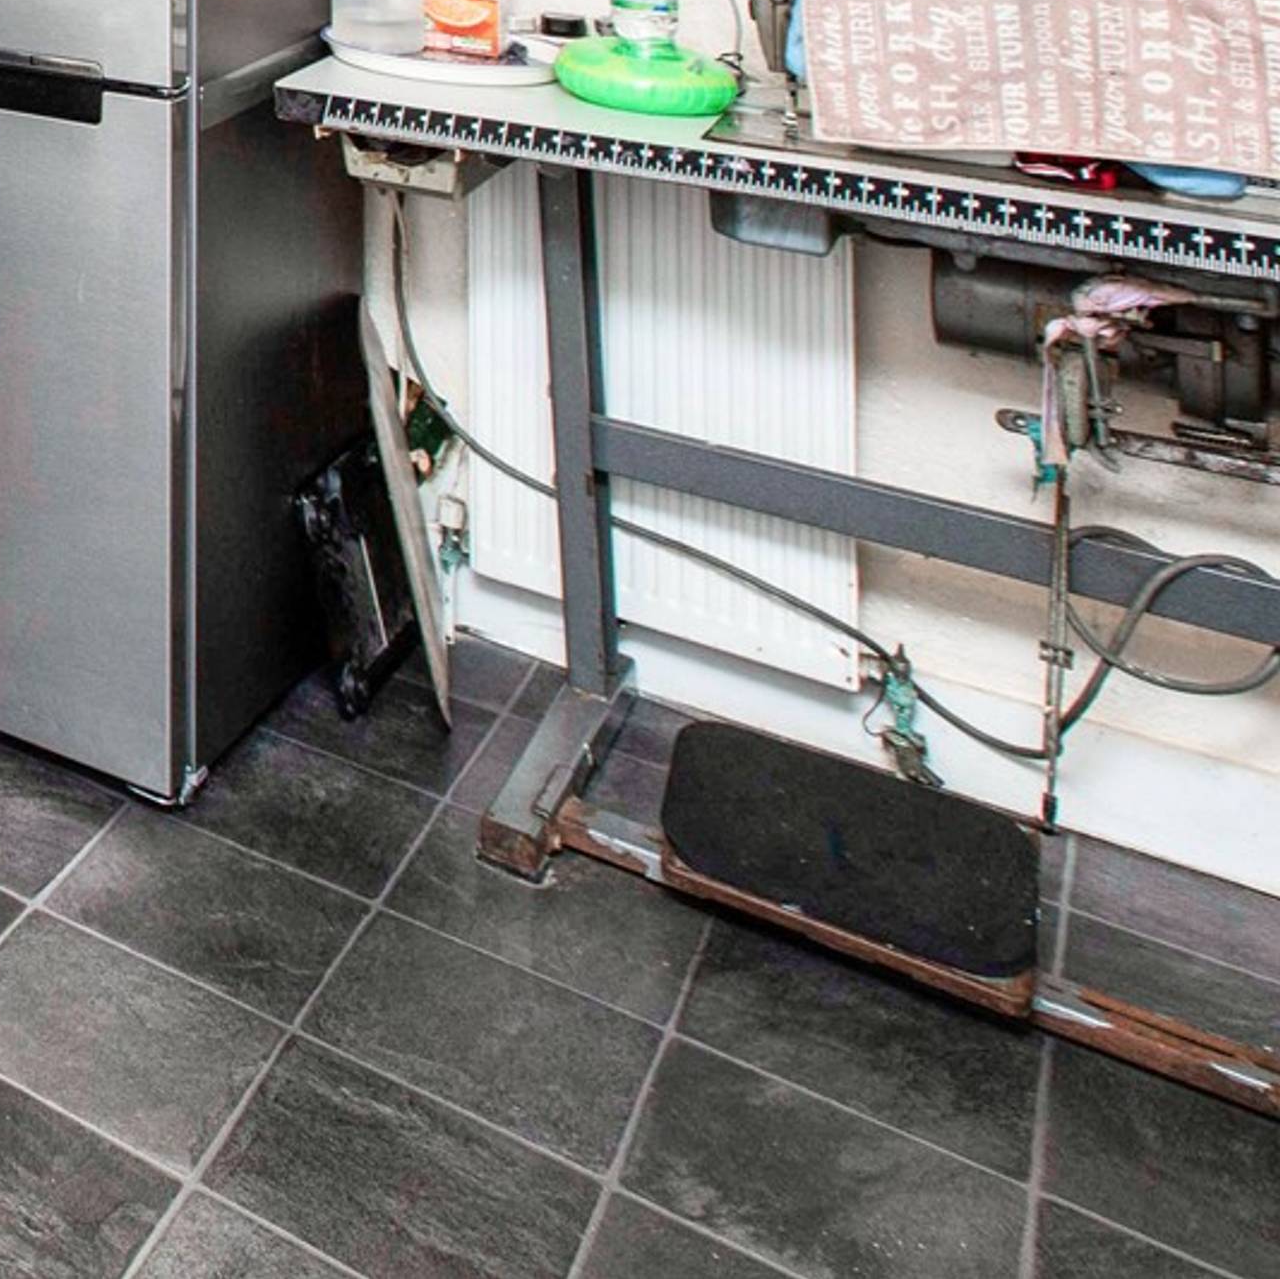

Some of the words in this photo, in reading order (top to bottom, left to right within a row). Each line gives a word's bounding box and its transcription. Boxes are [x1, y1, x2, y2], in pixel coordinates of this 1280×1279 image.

[815, 5, 846, 75] shine
[848, 2, 877, 65] TURN
[914, 6, 967, 62] dry
[994, 4, 1025, 73] TURN
[1033, 2, 1061, 65] spoon
[1059, 10, 1095, 82] shine
[1097, 2, 1126, 71] TURN
[1171, 16, 1227, 75] dry
[857, 68, 895, 131] your
[1001, 81, 1030, 146] YOUR
[1037, 71, 1060, 125] knife
[1073, 91, 1094, 129] and
[1104, 77, 1142, 141] your
